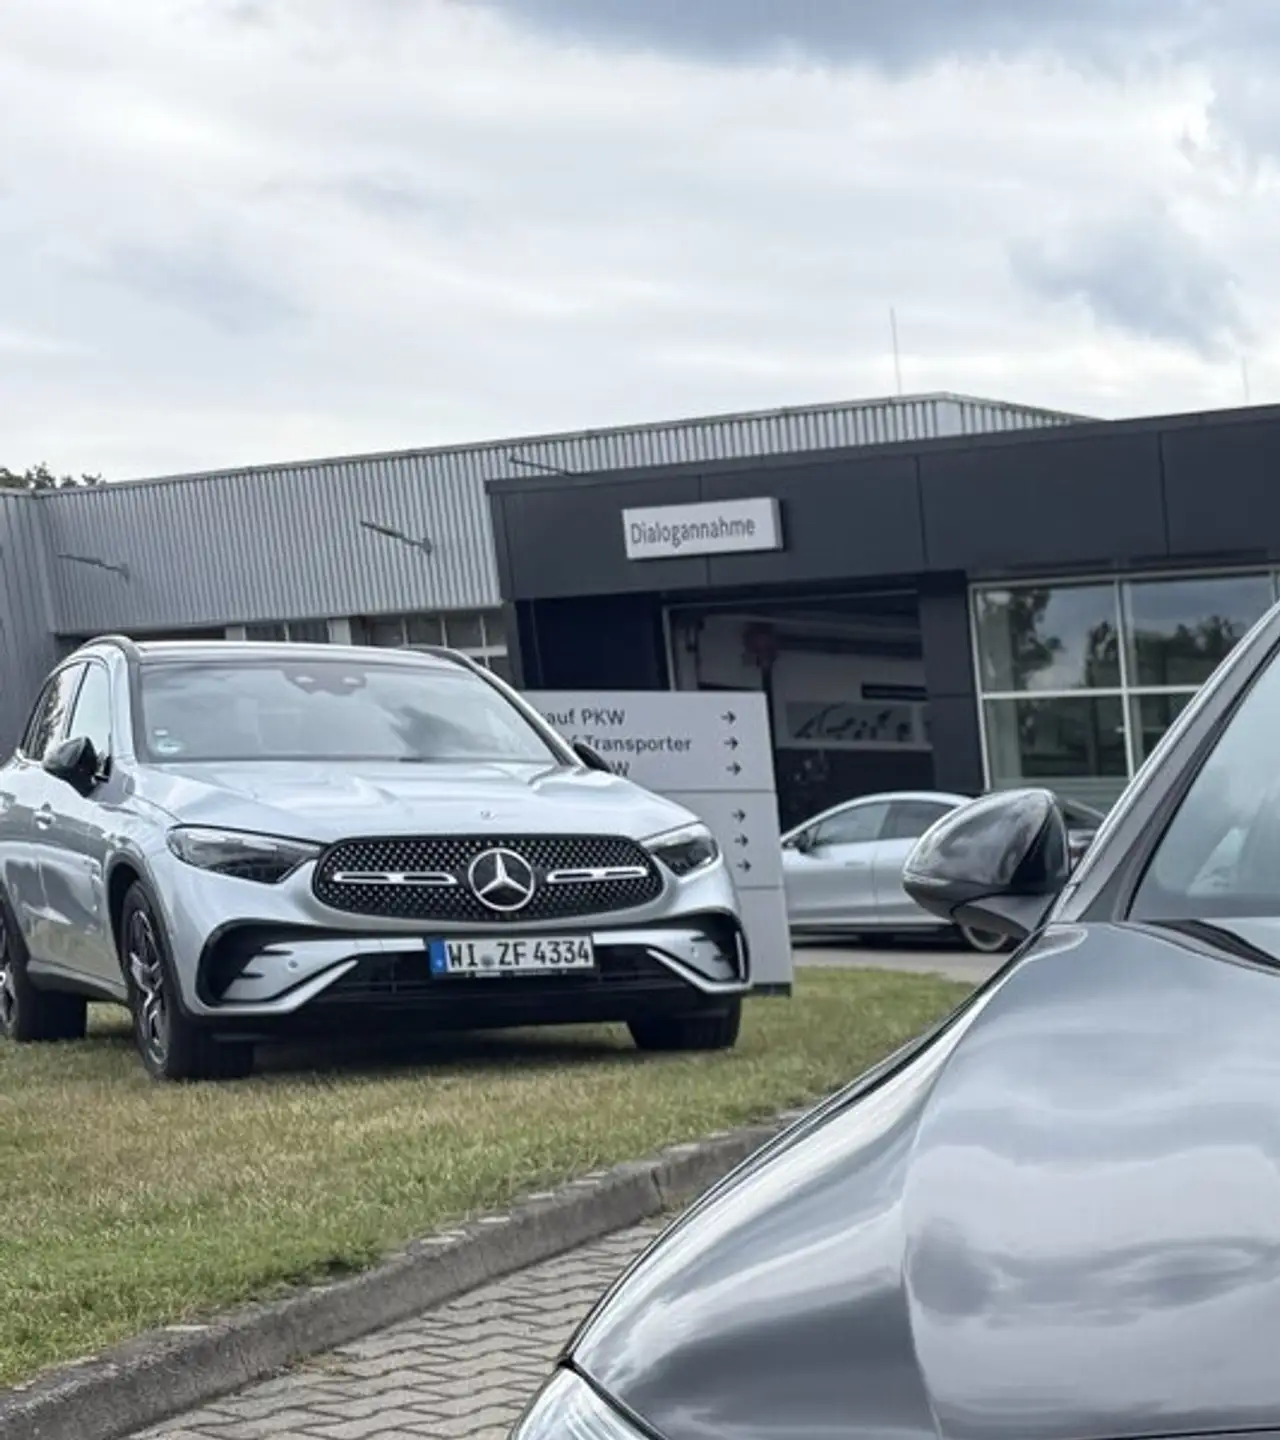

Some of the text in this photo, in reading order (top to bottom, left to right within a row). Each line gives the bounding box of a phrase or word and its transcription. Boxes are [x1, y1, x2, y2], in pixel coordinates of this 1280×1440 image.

[630, 516, 756, 548] Dialogannahme
[581, 708, 625, 725] PKW
[586, 735, 692, 754] Transporter
[497, 942, 527, 966] ZF
[533, 940, 590, 966] 4334
